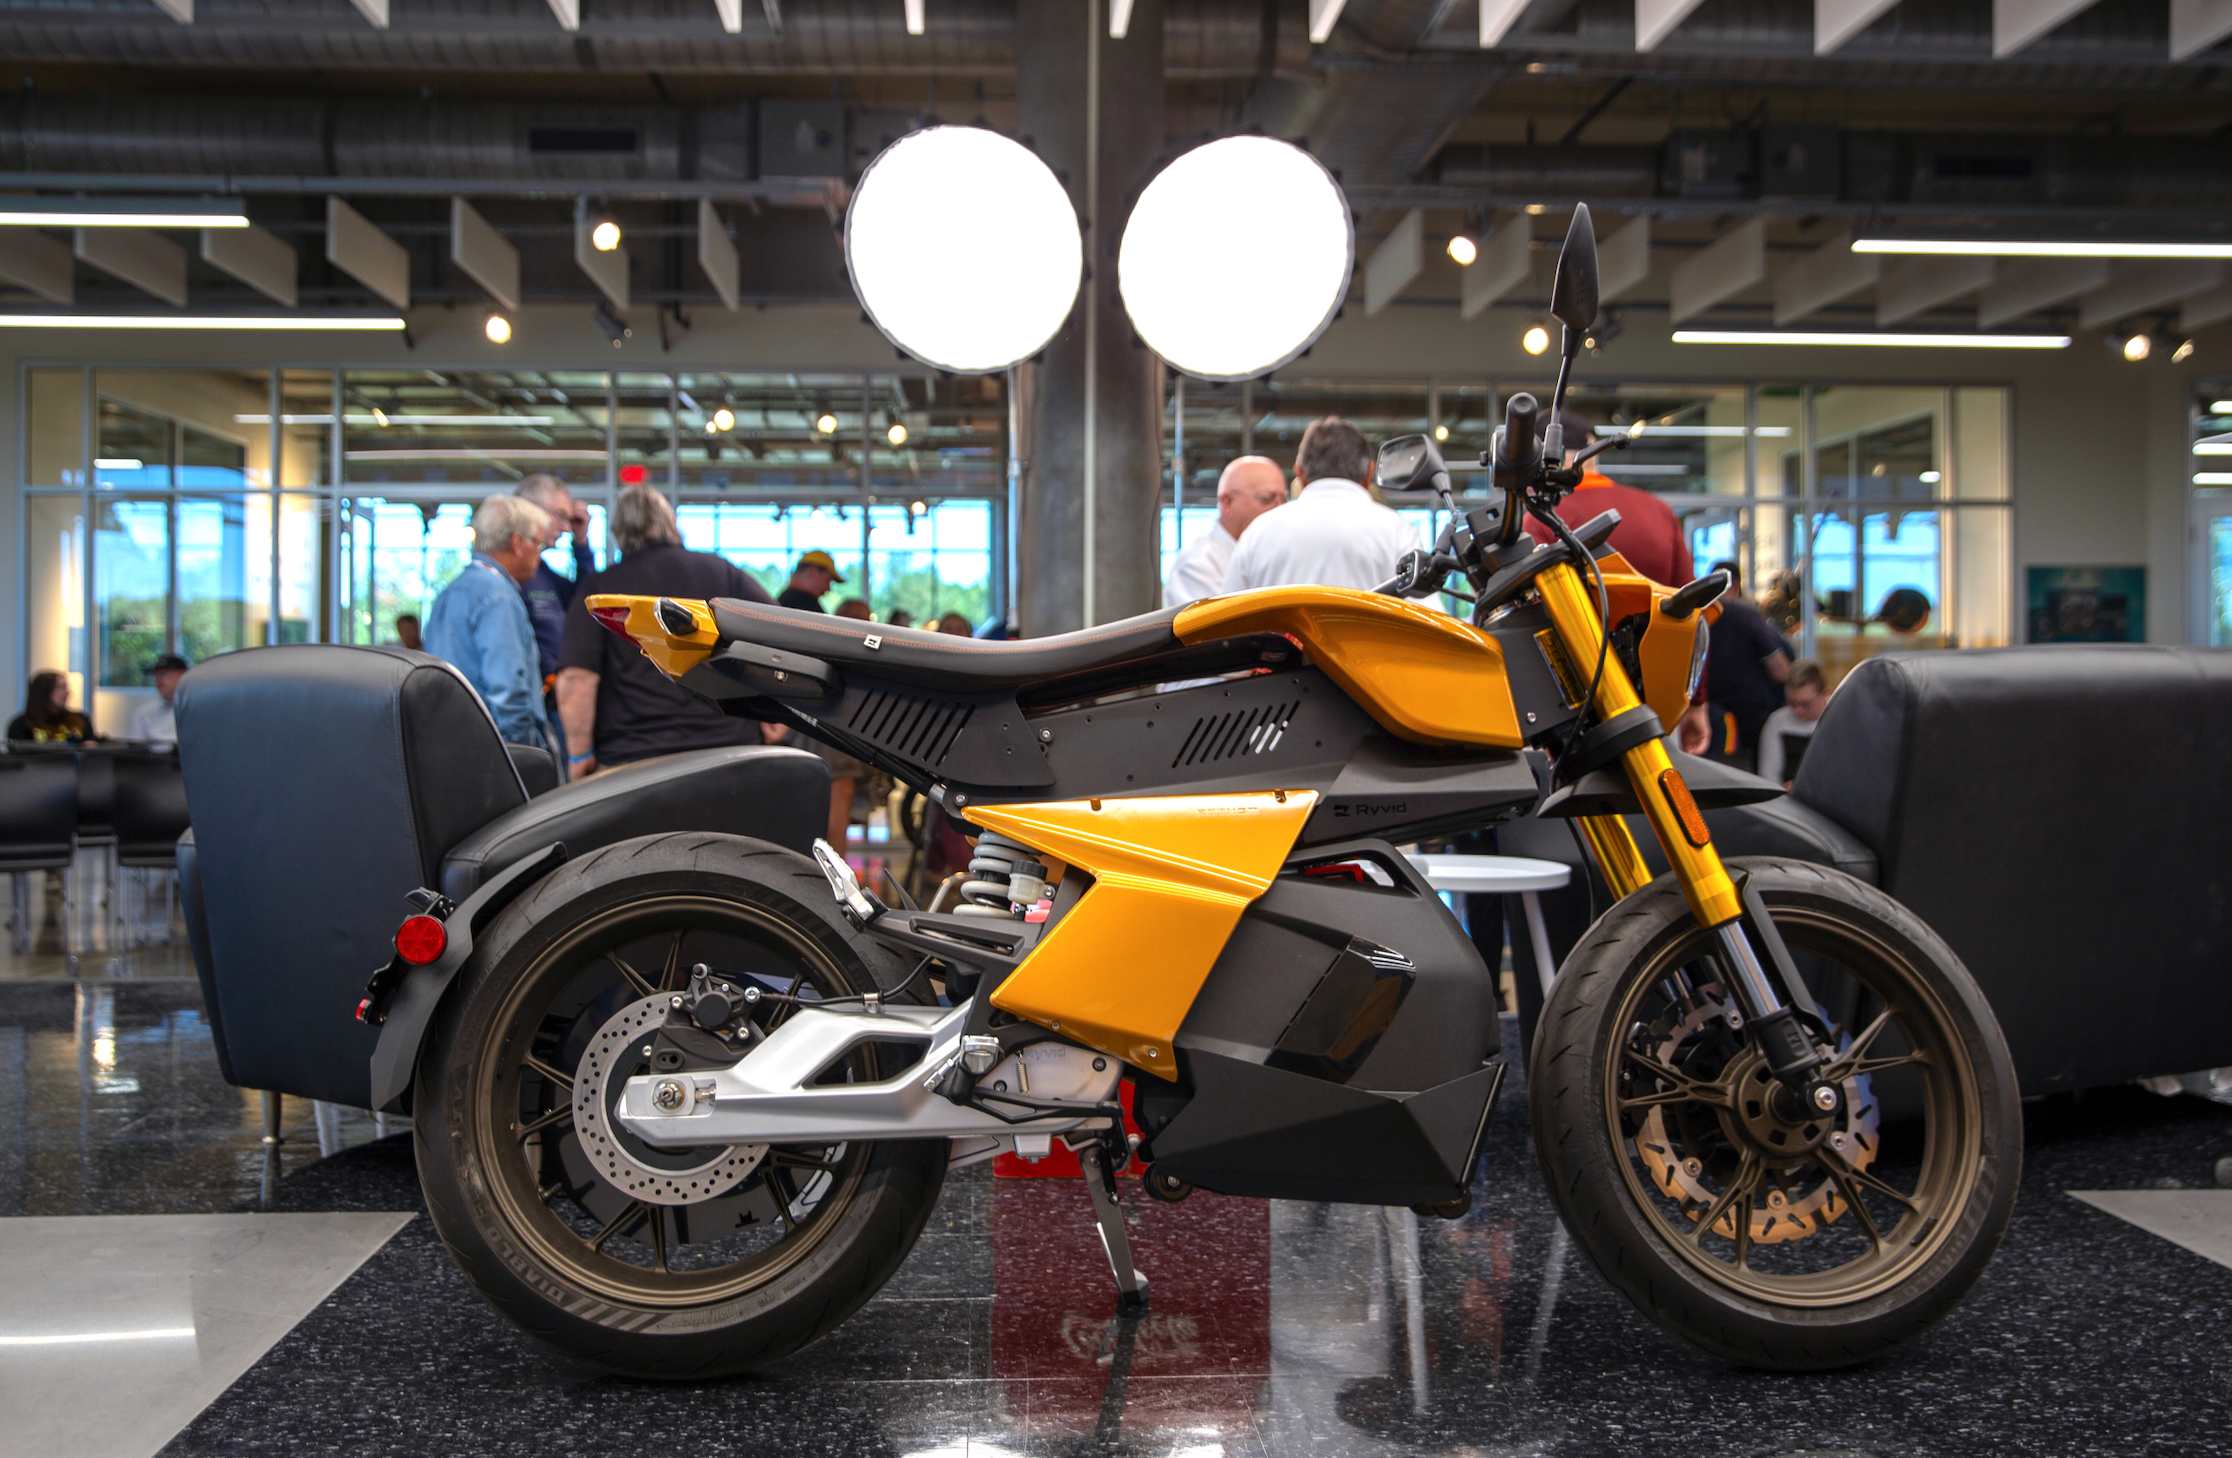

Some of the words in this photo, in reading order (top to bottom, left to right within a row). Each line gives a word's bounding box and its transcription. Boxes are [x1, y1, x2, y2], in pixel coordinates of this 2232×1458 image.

[1356, 803, 1407, 817] Ryvid
[1023, 1046, 1066, 1060] Ryvid
[486, 1226, 566, 1303] DIABLO
[1901, 1231, 1969, 1298] DIABLO
